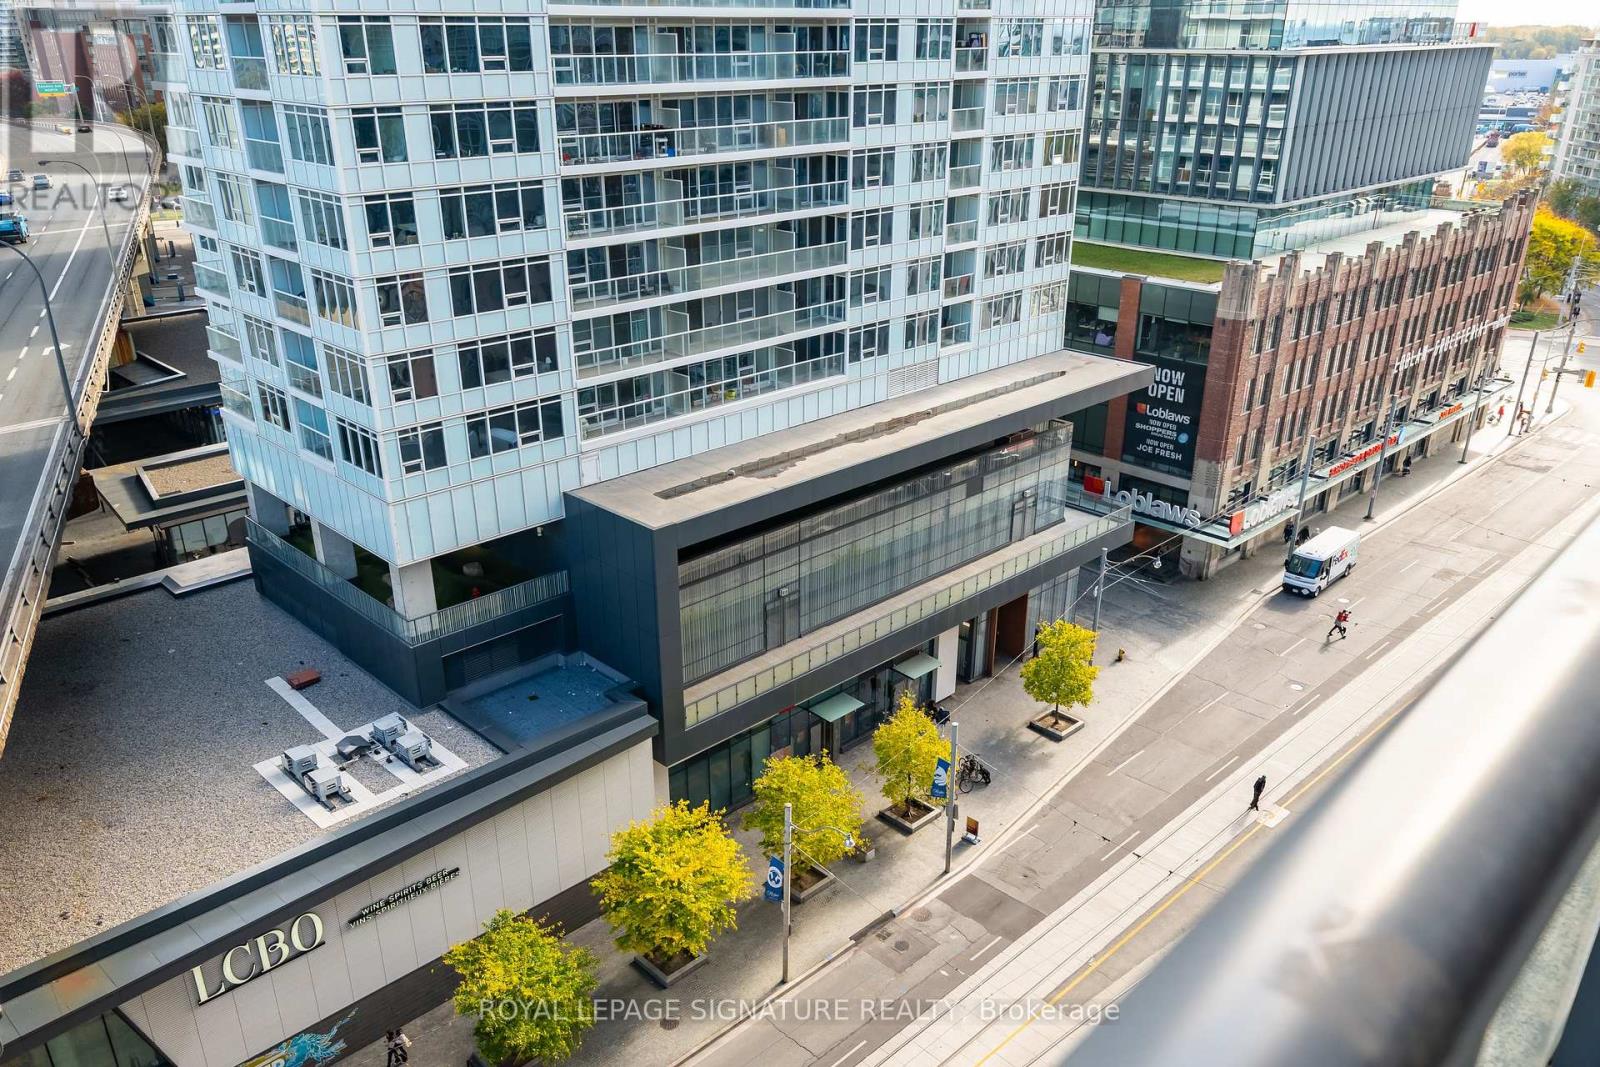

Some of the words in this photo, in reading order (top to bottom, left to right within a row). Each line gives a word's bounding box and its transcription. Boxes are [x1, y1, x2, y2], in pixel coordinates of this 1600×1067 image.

[1154, 367, 1185, 386] NOW
[1148, 383, 1185, 403] OPEN
[1147, 404, 1190, 424] Loblaws
[1135, 422, 1177, 437] SHOPPERS
[1149, 419, 1161, 427] NOW
[1162, 422, 1177, 430] OPEN
[1136, 443, 1153, 454] JOE
[1155, 448, 1182, 461] FRESH
[1160, 442, 1174, 450] OPEN
[1104, 480, 1201, 529] Loblaws
[361, 899, 386, 915] WINE
[388, 881, 424, 903] SPIRITS
[426, 869, 449, 885] BEER
[349, 914, 372, 929] VINS
[192, 912, 323, 1005] LCBO
